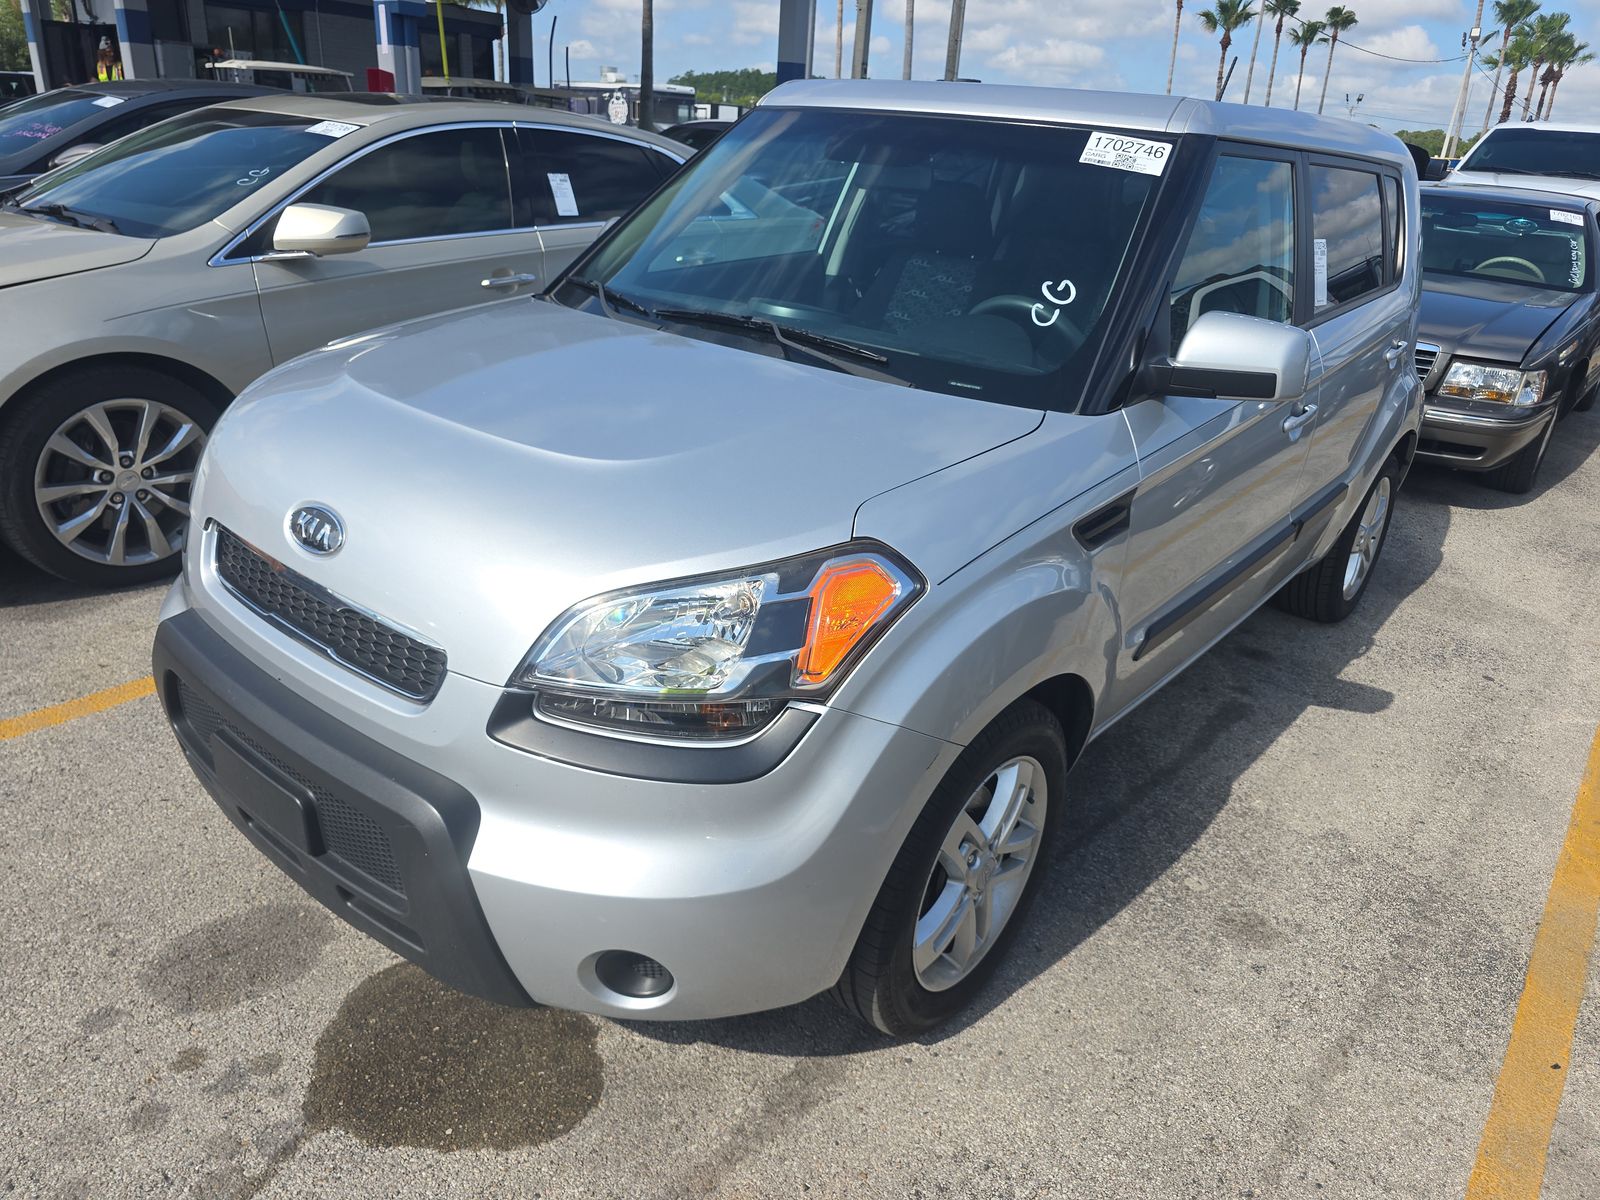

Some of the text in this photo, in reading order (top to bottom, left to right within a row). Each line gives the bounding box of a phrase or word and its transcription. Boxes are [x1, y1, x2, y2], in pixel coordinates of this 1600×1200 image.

[1095, 136, 1166, 158] 1702746
[237, 166, 270, 186] CG
[1031, 279, 1077, 327] CG
[297, 511, 332, 550] KIA
